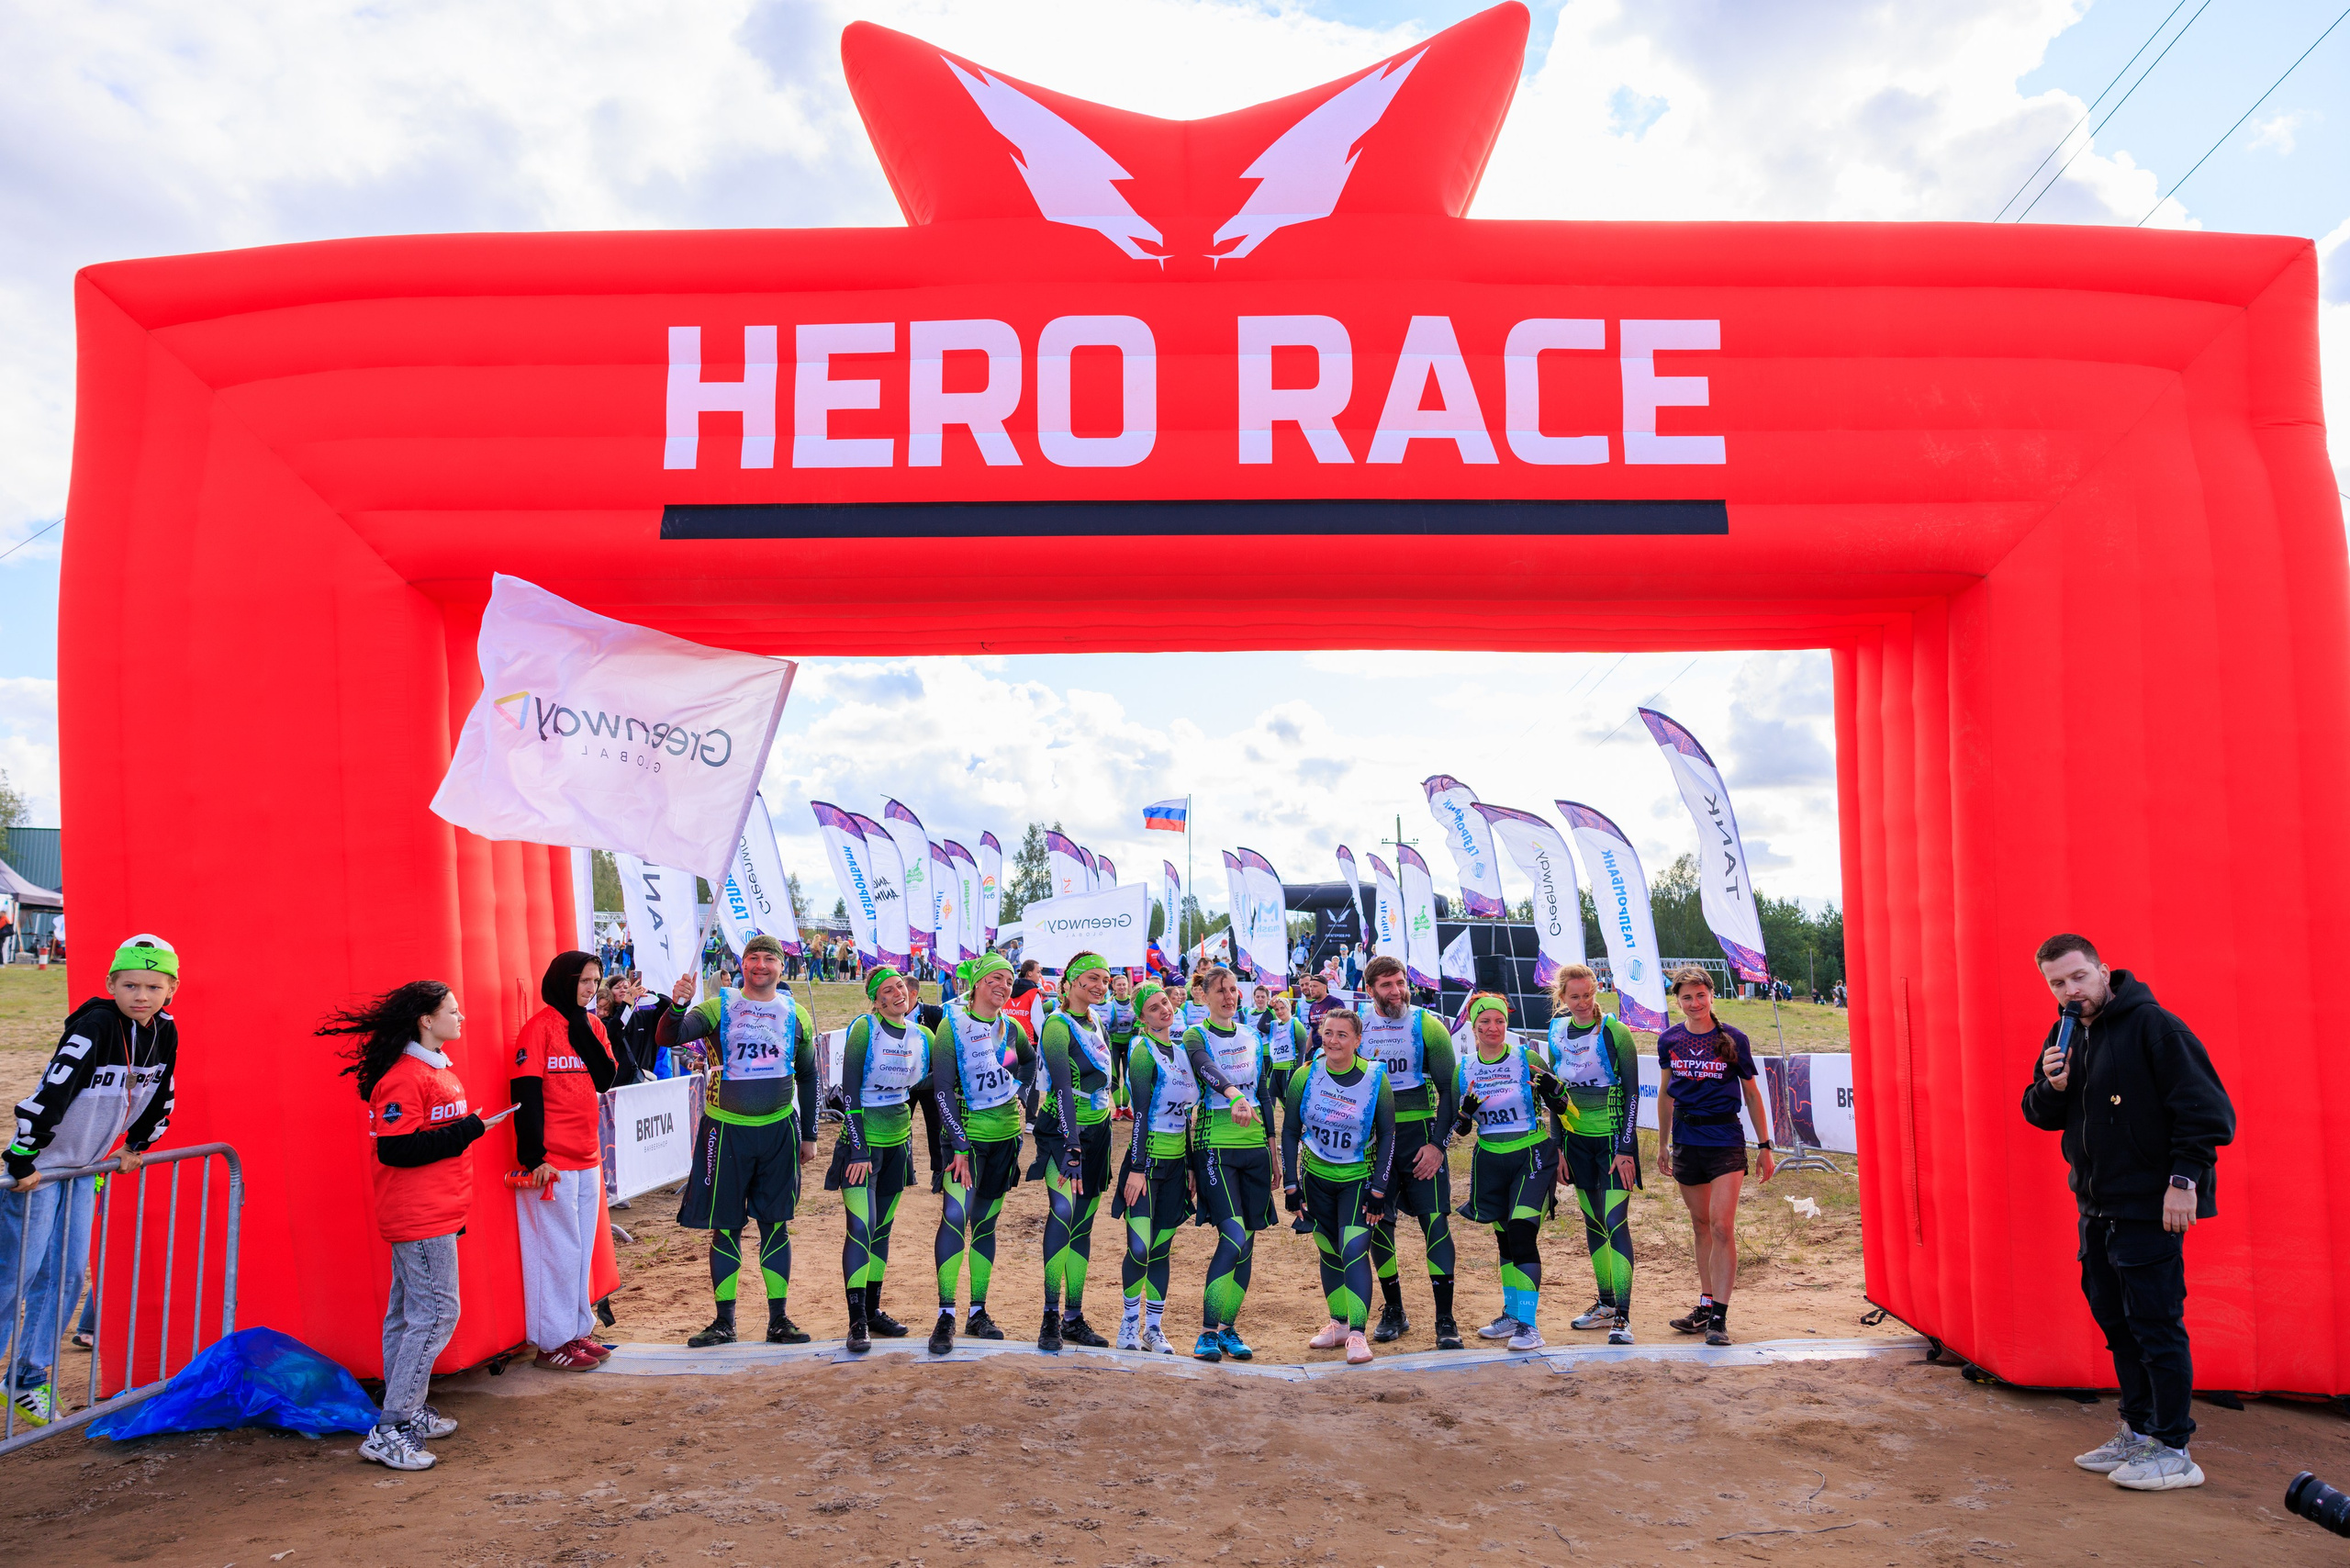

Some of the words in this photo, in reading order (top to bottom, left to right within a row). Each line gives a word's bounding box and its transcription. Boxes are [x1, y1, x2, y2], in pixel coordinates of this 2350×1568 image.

[664, 313, 1158, 470] HERO
[1237, 316, 1729, 467] RACE
[1273, 1045, 1290, 1055] 7292
[1369, 1037, 1402, 1046] Greenway
[737, 1043, 779, 1060] 7314
[879, 1064, 913, 1073] Greenway
[1694, 1071, 1723, 1080] ГЕРОЕВ
[1320, 1090, 1337, 1099] ГОНКА
[1337, 1095, 1357, 1104] ГЕРОЕВ
[1475, 1088, 1508, 1097] Greenway
[937, 1092, 961, 1135] Greenway
[1058, 1089, 1068, 1132] Greenway
[1315, 1104, 1350, 1120] Greenway
[1479, 1107, 1519, 1125] 7381
[636, 1113, 674, 1142] BRITVA
[1624, 1099, 1637, 1144] Greenway
[1132, 1112, 1142, 1158] Greenway
[1313, 1126, 1351, 1148] 7316
[644, 1140, 668, 1153] BARBERSHOP
[704, 1135, 717, 1186] Greenway
[1382, 1135, 1395, 1182] Greenway
